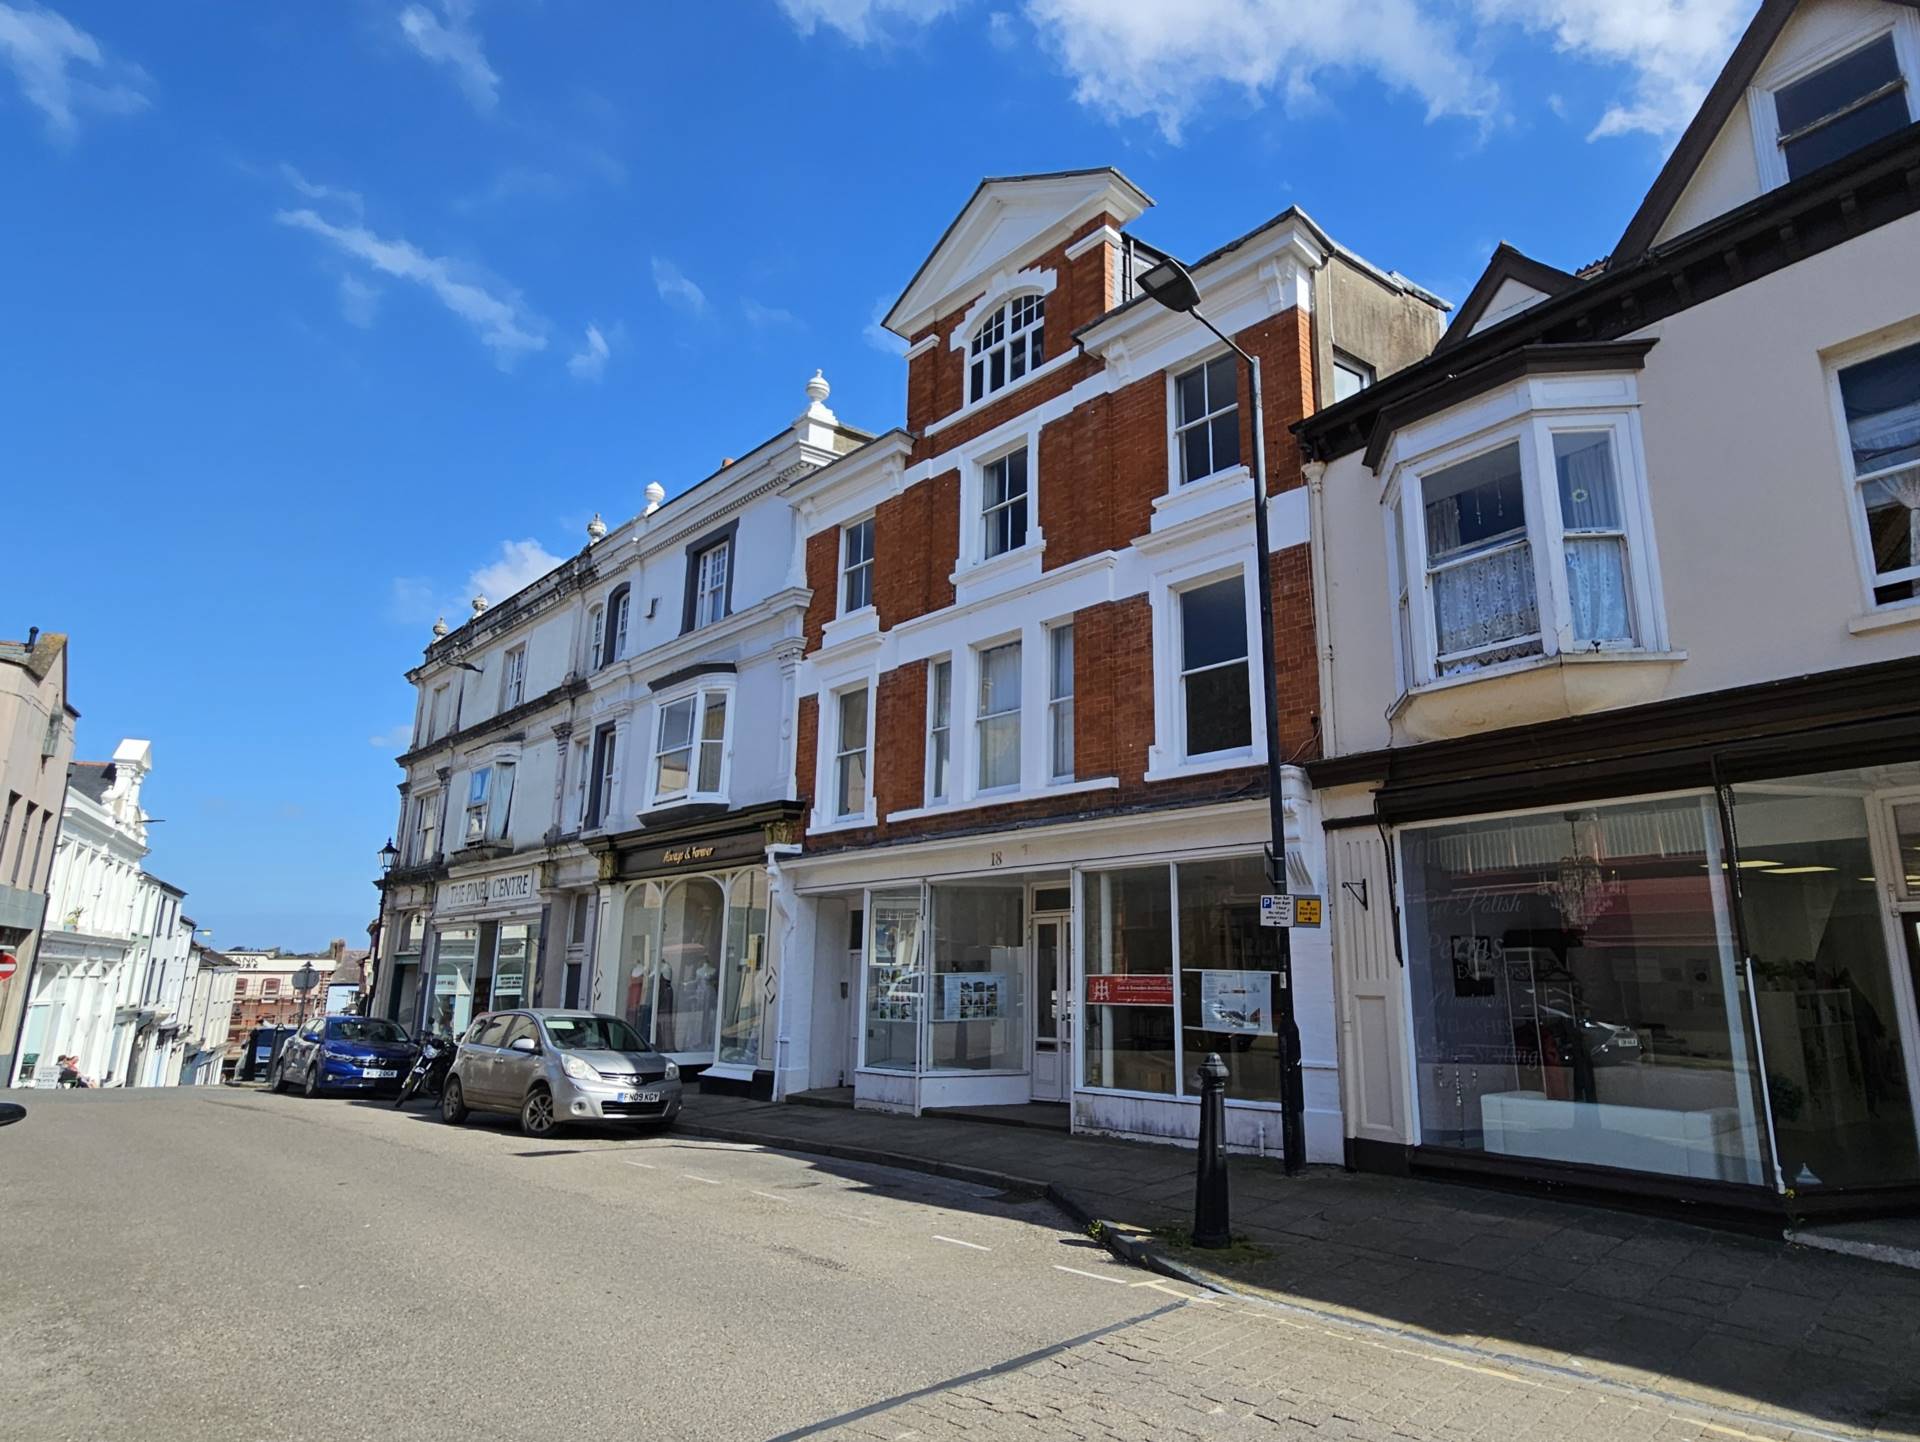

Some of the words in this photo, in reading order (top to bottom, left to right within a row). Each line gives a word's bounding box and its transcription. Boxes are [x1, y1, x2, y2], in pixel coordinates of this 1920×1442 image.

[684, 847, 690, 860] &
[691, 846, 714, 859] Forever
[991, 851, 1002, 866] 18
[451, 884, 465, 904] THE
[492, 874, 529, 899] CENTRE
[1456, 887, 1521, 916] Polish
[1427, 932, 1504, 960] Perms
